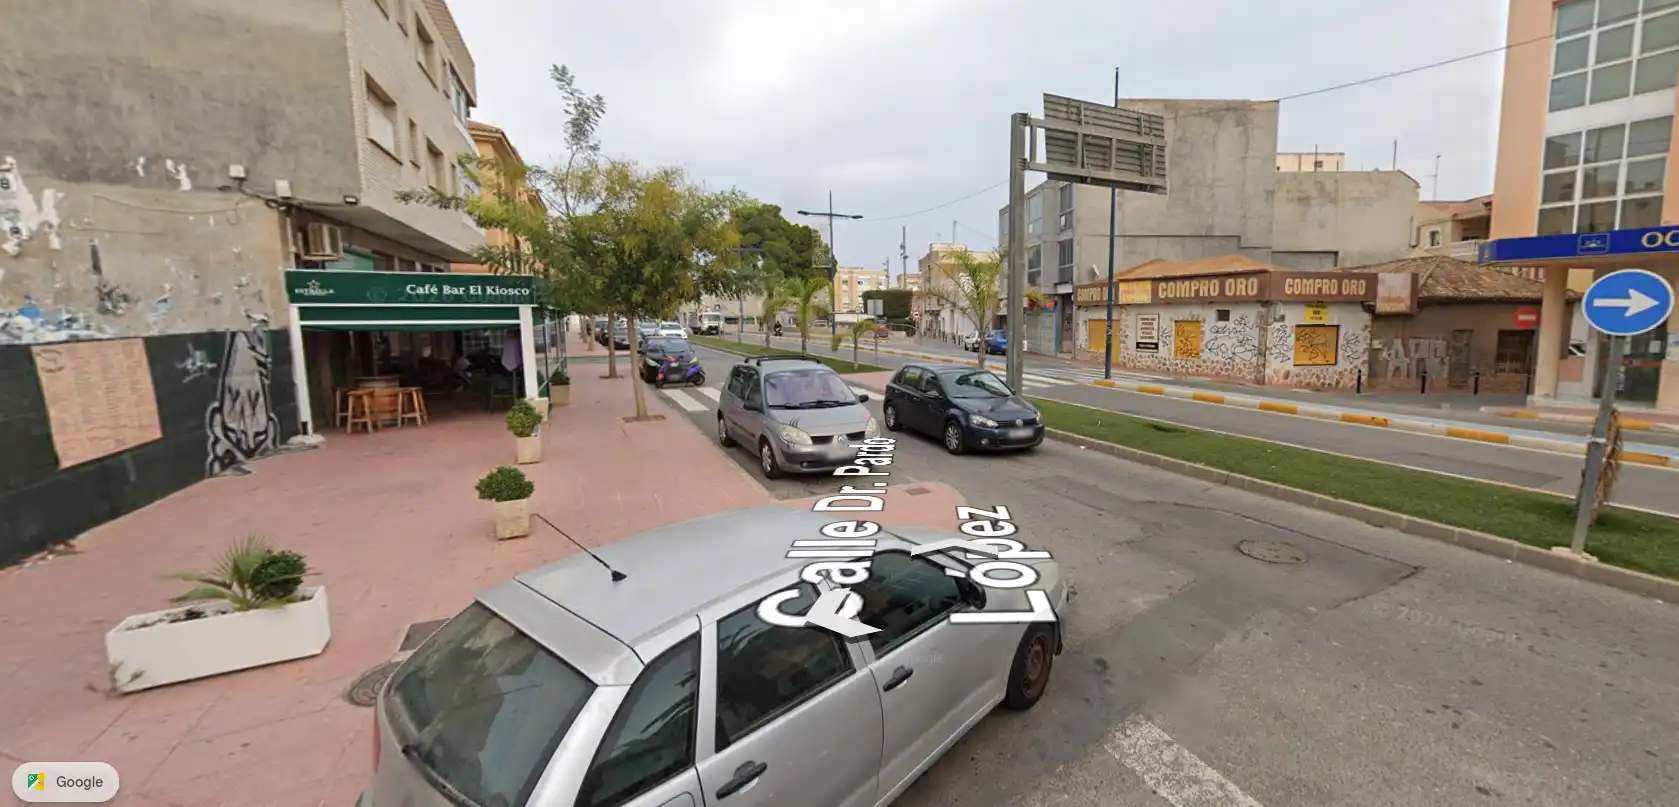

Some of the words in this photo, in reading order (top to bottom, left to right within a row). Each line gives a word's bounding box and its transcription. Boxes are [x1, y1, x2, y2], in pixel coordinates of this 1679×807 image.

[406, 284, 438, 295] Café
[442, 285, 465, 295] Bar
[469, 285, 482, 295] El
[486, 285, 530, 296] Kiosco
[1158, 279, 1220, 299] COMPRO
[1225, 277, 1258, 296] ORO
[1284, 278, 1338, 295] COMPRO
[1341, 279, 1366, 296] ORO
